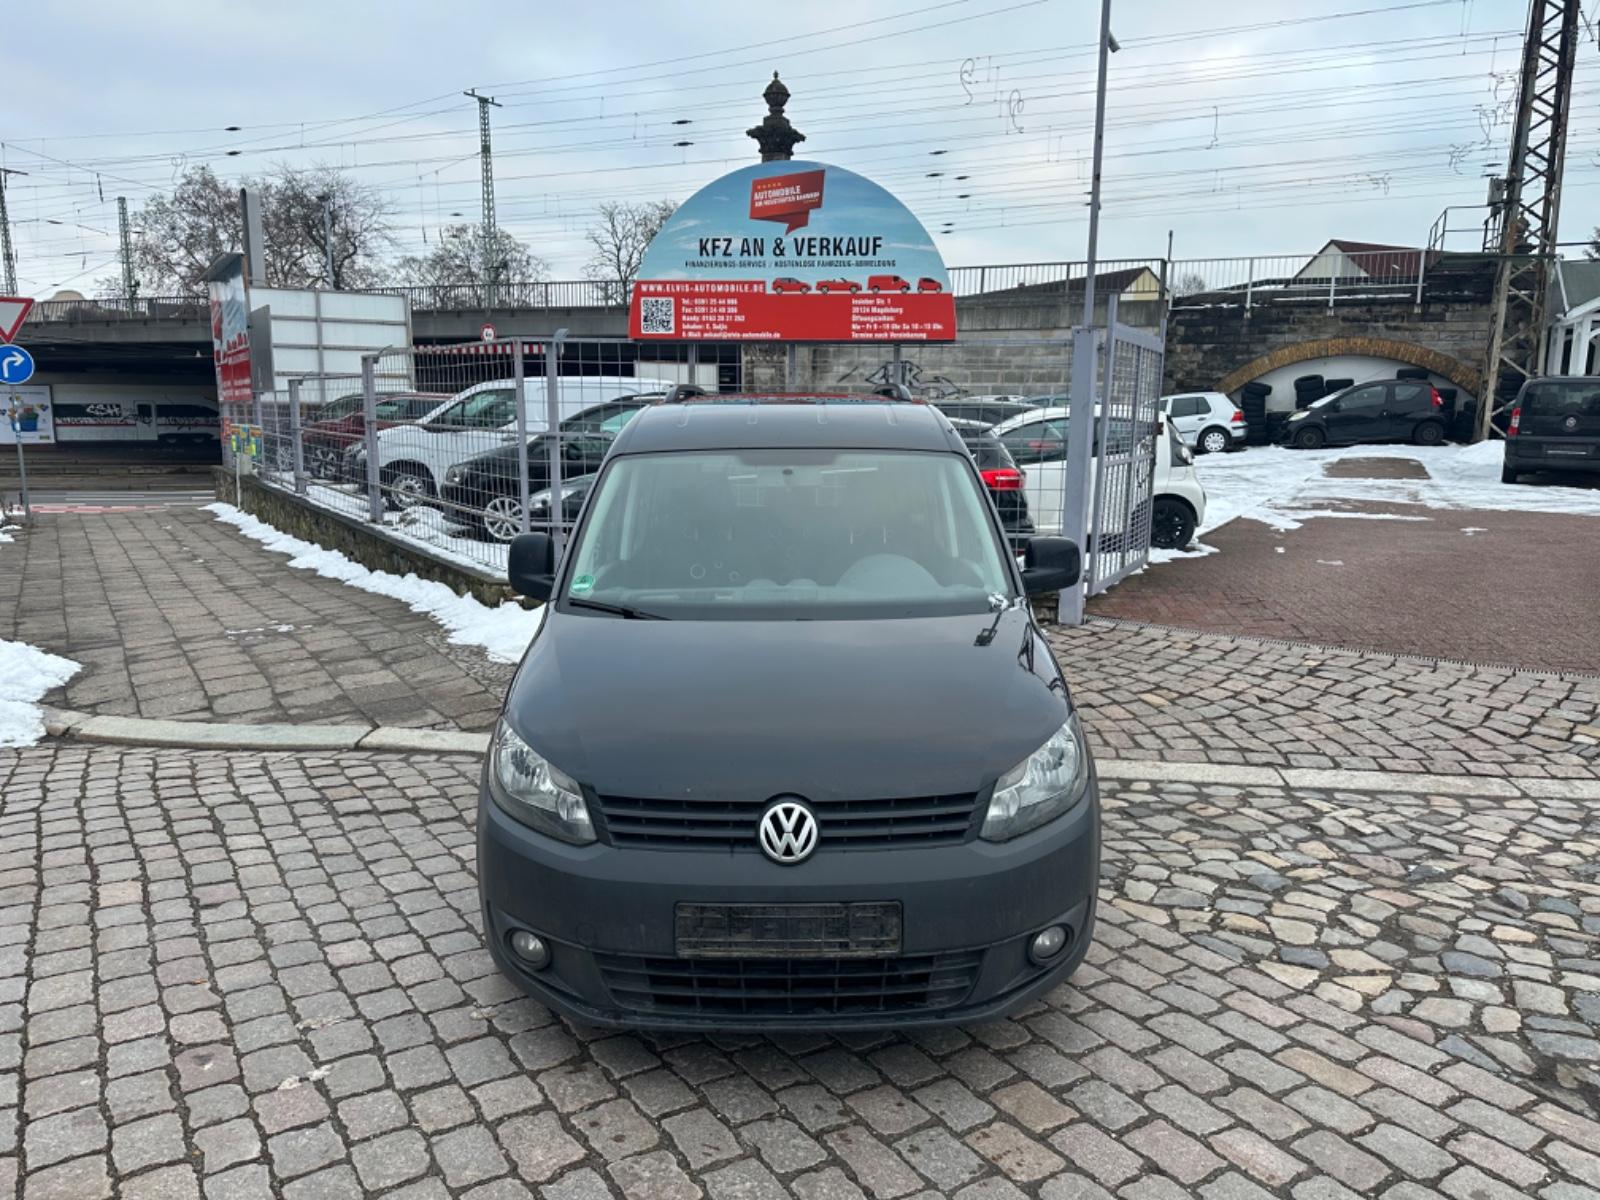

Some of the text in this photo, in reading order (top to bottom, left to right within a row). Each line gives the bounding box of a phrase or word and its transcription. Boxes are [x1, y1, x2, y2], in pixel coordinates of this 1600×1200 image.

[754, 185, 801, 201] AUTOMOBILE
[699, 236, 882, 257] KFZ AN & VERKAUF
[774, 260, 816, 268] KOSTENLOSE
[641, 284, 765, 293] WWW.ELVIS-AUTOMOBILE.DE
[871, 306, 903, 315] Magdeburg
[760, 803, 818, 862] VW
